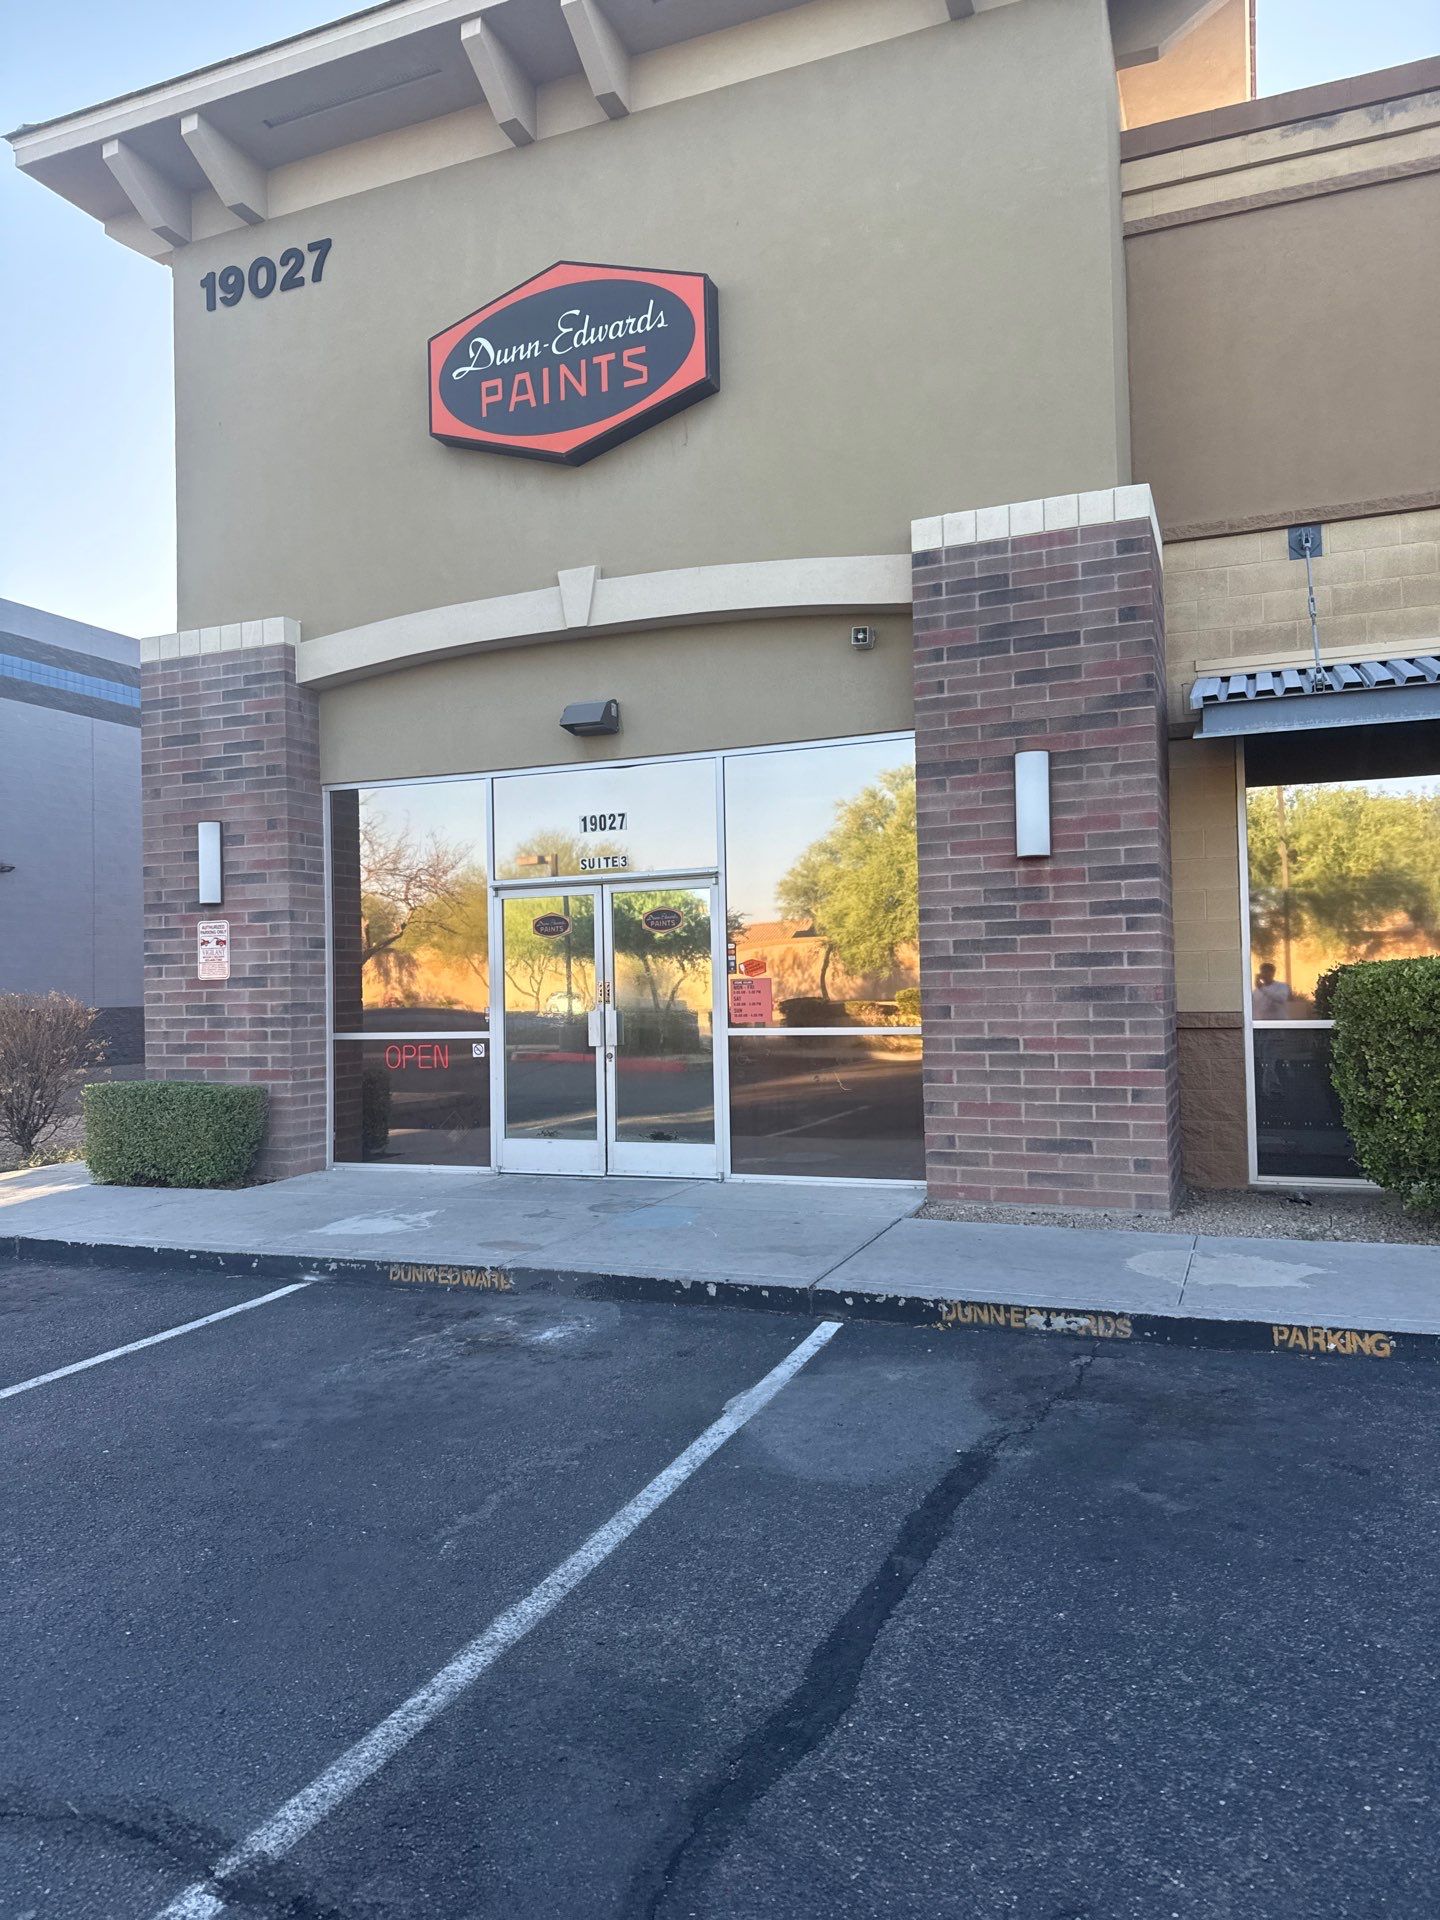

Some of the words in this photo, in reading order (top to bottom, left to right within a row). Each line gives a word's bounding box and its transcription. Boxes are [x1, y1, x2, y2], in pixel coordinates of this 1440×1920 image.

[200, 238, 332, 312] 19027
[451, 299, 669, 381] Dunn-Edwards
[480, 345, 649, 418] PAINTS
[581, 812, 626, 833] 19027
[540, 925, 564, 933] PAINTS
[650, 919, 676, 927] PAINTS
[384, 1044, 450, 1070] OPEN
[939, 1302, 1133, 1339] DUNN-ERDS
[1271, 1325, 1391, 1358] PARKING
